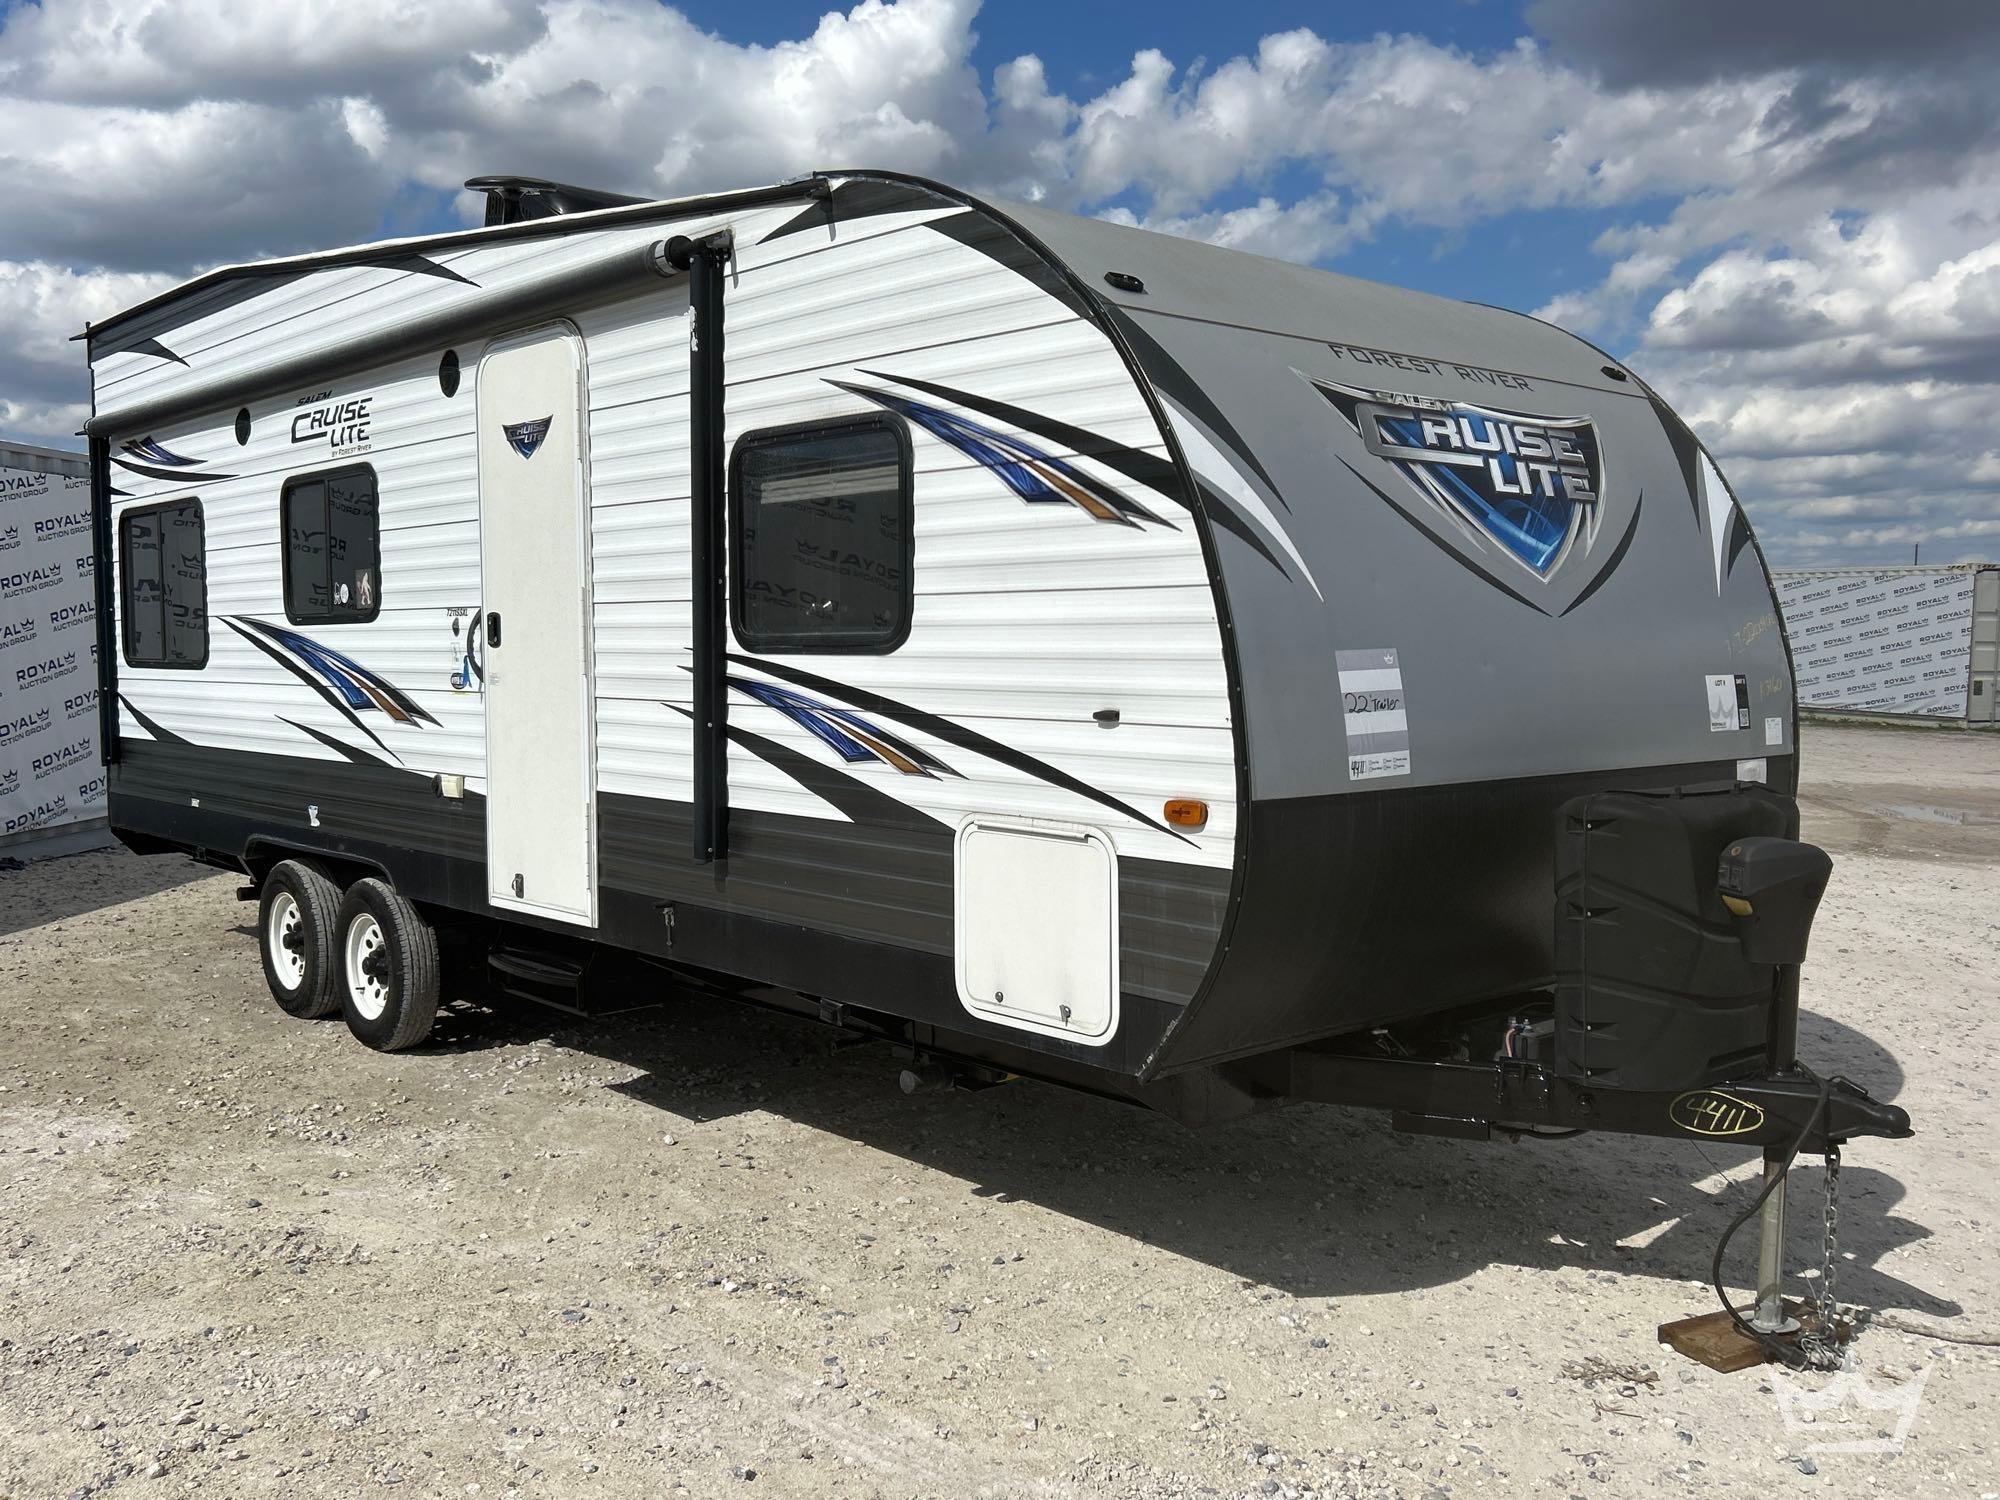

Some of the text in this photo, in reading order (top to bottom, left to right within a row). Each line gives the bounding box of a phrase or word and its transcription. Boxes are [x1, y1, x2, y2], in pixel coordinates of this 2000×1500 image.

[1328, 344, 1535, 392] FOREST RIVER
[296, 390, 332, 407] SALEM
[1375, 391, 1452, 411] SALEM
[291, 397, 373, 443] CRUISE
[331, 421, 371, 448] LITE
[1355, 401, 1587, 467] CRUISE
[0, 476, 35, 492] OYAL
[65, 480, 91, 490] AUCTIO
[1489, 457, 1597, 503] LITE
[0, 487, 49, 503] CTION GROUP
[34, 514, 81, 533] ROYAL
[37, 528, 69, 542] AUCTION
[0, 541, 21, 552] ROUP
[0, 568, 50, 590] ROYAL
[1933, 575, 1959, 584] ROYAL
[3, 577, 64, 599] AUCTION GROUP
[1783, 580, 1806, 589] ROYAL
[1837, 582, 1861, 591] ROYAL
[1893, 584, 1917, 594] ROYAL
[1802, 591, 1826, 600] ROYAL
[1856, 594, 1880, 603] ROYAL
[1957, 589, 1974, 598] ROY
[1917, 597, 1941, 607] ROYAL
[50, 601, 95, 623] ROYAL
[1820, 604, 1842, 612] ROYAL
[1877, 607, 1901, 616] ROYAL
[1786, 612, 1807, 620] ROYAL
[1840, 616, 1864, 624] ROYAL
[1937, 611, 1962, 620] ROYAL
[53, 615, 83, 632] AUCTION
[1896, 620, 1920, 629] ROYAL
[1859, 628, 1883, 637] ROYAL
[1920, 633, 1943, 642] ROYAL
[14, 632, 38, 646] GROUP
[1823, 637, 1847, 646] ROYAL
[1880, 642, 1903, 650] ROYAL
[1844, 650, 1866, 659] ROYAL
[1940, 647, 1965, 656] ROYAL
[1809, 657, 1830, 665] ROYAL
[1900, 655, 1923, 665] ROYAL
[16, 657, 65, 682] ROYAL
[1862, 663, 1886, 672] ROYAL
[19, 665, 79, 691] AUCTION GROUP
[1826, 671, 1848, 679] ROYAL
[1923, 668, 1947, 678] ROYAL
[1884, 676, 1907, 685] ROYAL
[1847, 683, 1870, 691] ROYAL
[1944, 684, 1968, 692] ROYA
[64, 689, 100, 711] ROYA
[1811, 691, 1834, 699] ROYAL
[1904, 691, 1927, 699] ROYAL
[1865, 698, 1889, 706] ROYAL
[1927, 704, 1952, 713] ROYAL
[0, 714, 38, 737] OYAL
[0, 722, 52, 747] CTION GROUP
[32, 744, 80, 772] ROYAL
[35, 750, 93, 781] AUCTION GROUP
[0, 783, 21, 797] ROUP
[79, 776, 107, 797] ROY
[83, 789, 107, 805] AUCTIO
[5, 803, 55, 833] ROYAL
[43, 808, 69, 825] GROUP
[1687, 1098, 1746, 1132] 4411
